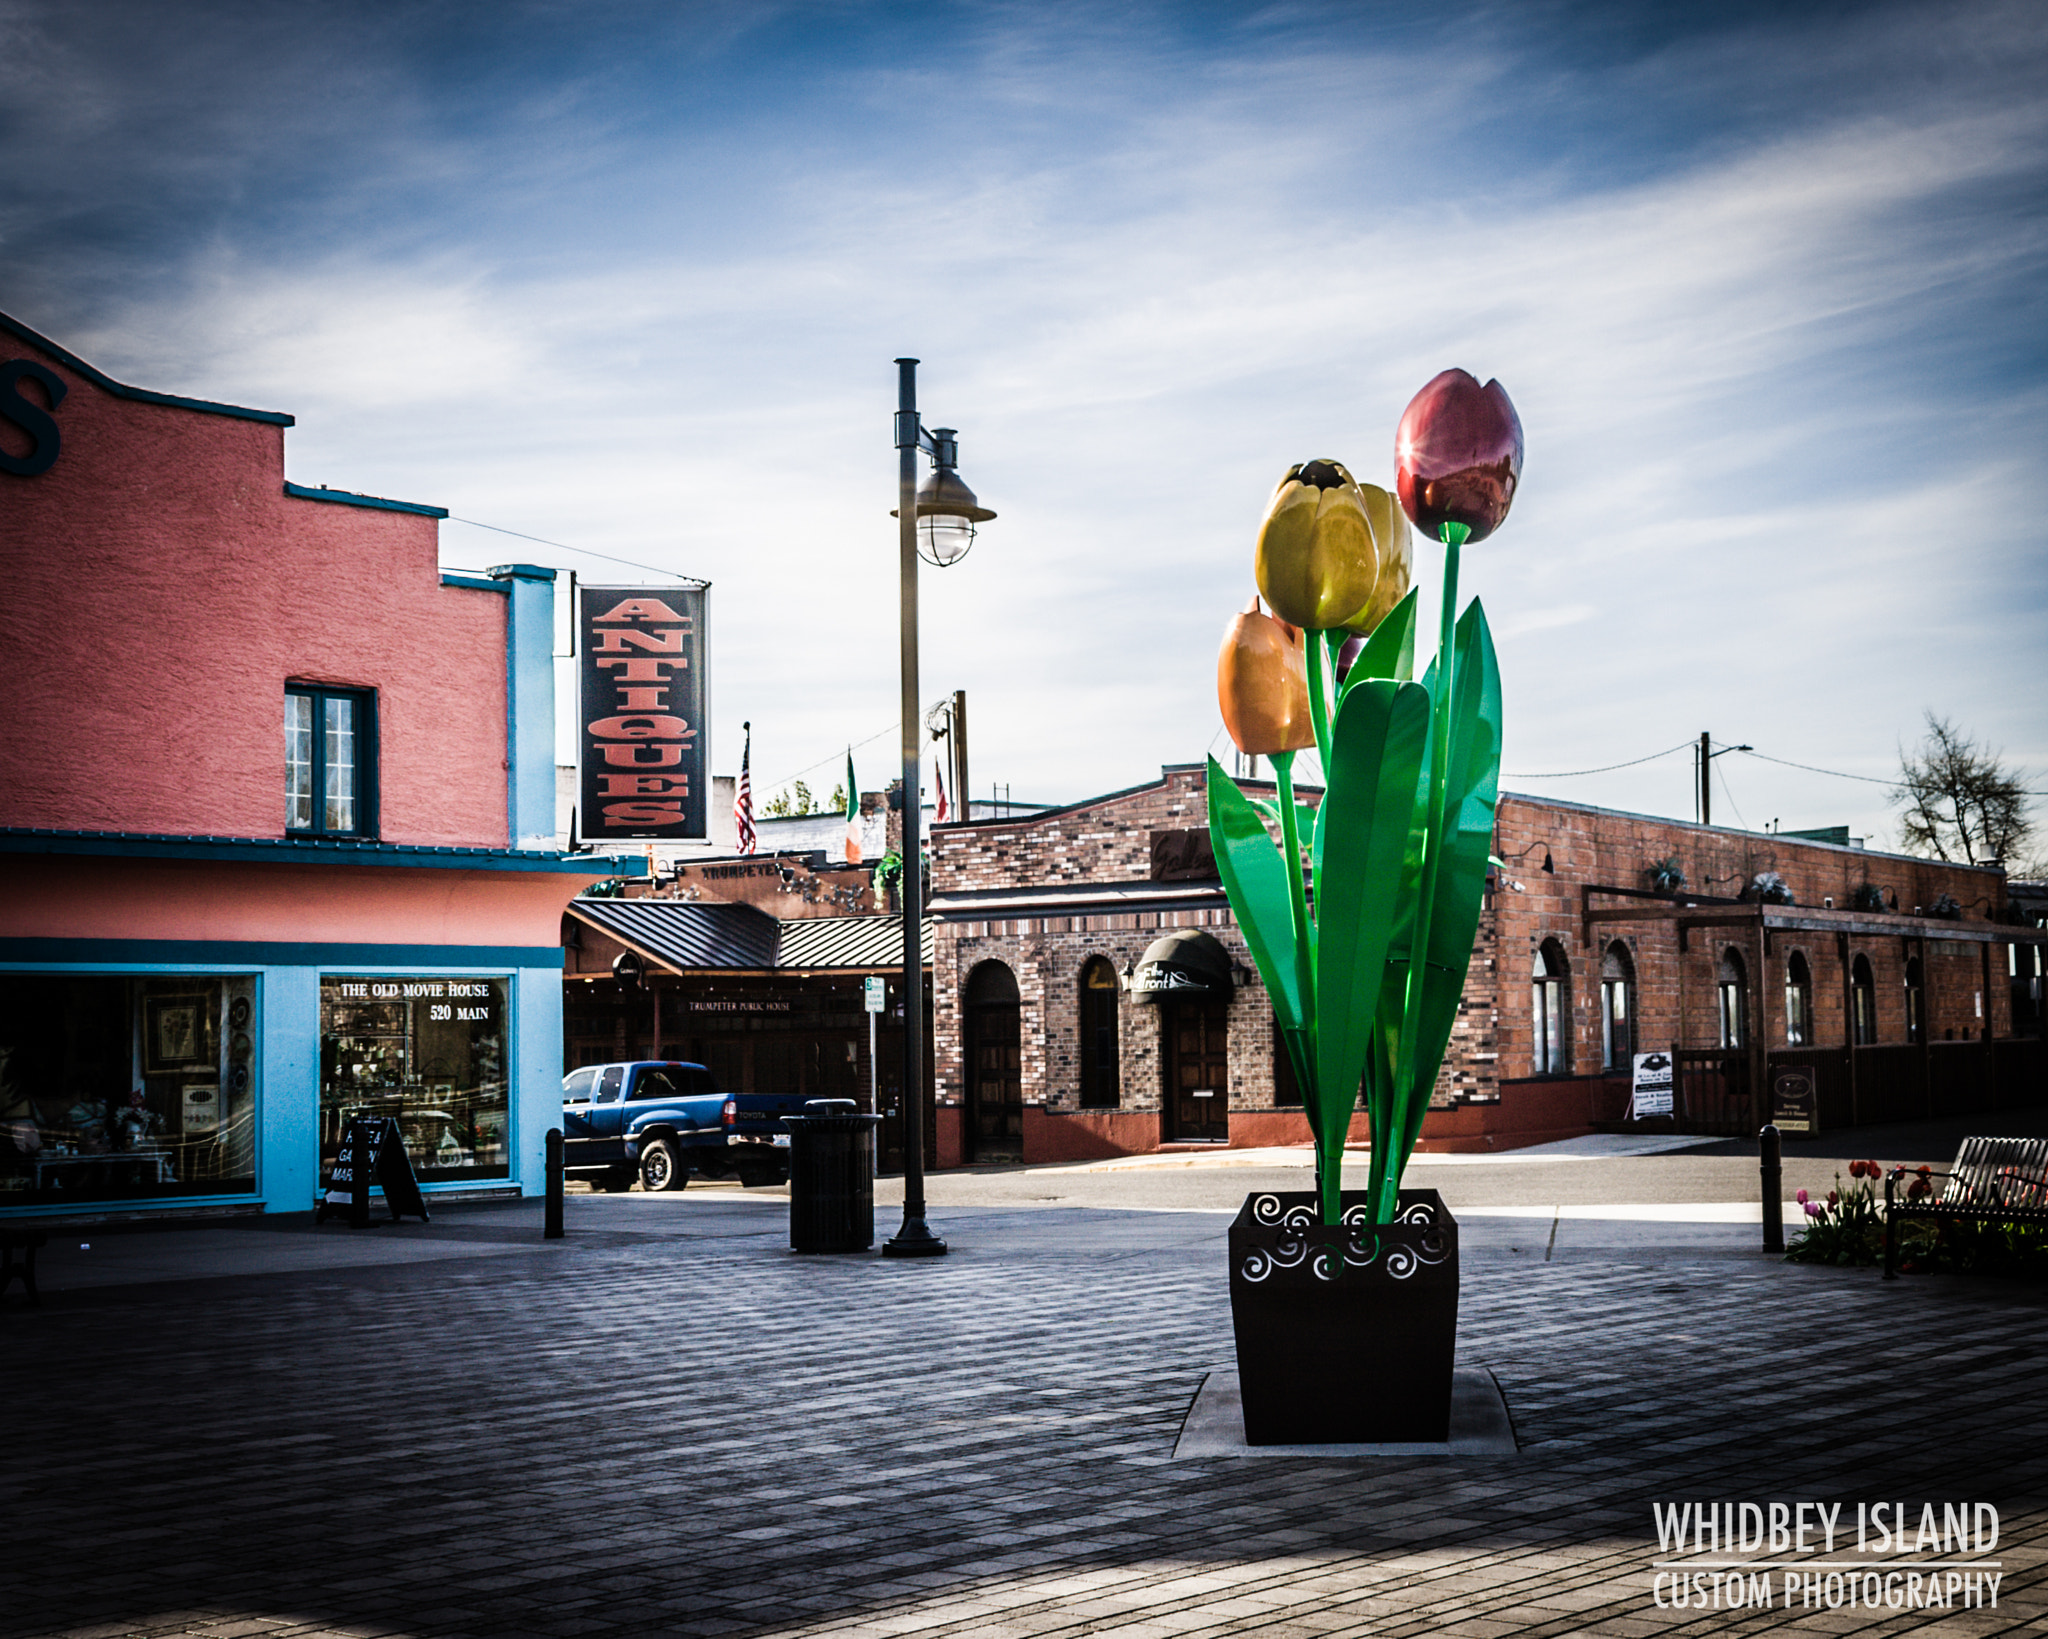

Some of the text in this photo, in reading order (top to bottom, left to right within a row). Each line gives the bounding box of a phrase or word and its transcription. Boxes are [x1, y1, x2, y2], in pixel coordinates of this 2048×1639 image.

[588, 598, 697, 826] ANTIQUES
[341, 984, 490, 997] THE OLD MOVIE HOUSE
[430, 1005, 489, 1021] 520 MAIN
[689, 1002, 791, 1012] TRUMPETER PUBLIC HOUSE
[738, 1111, 767, 1119] TOYOTA
